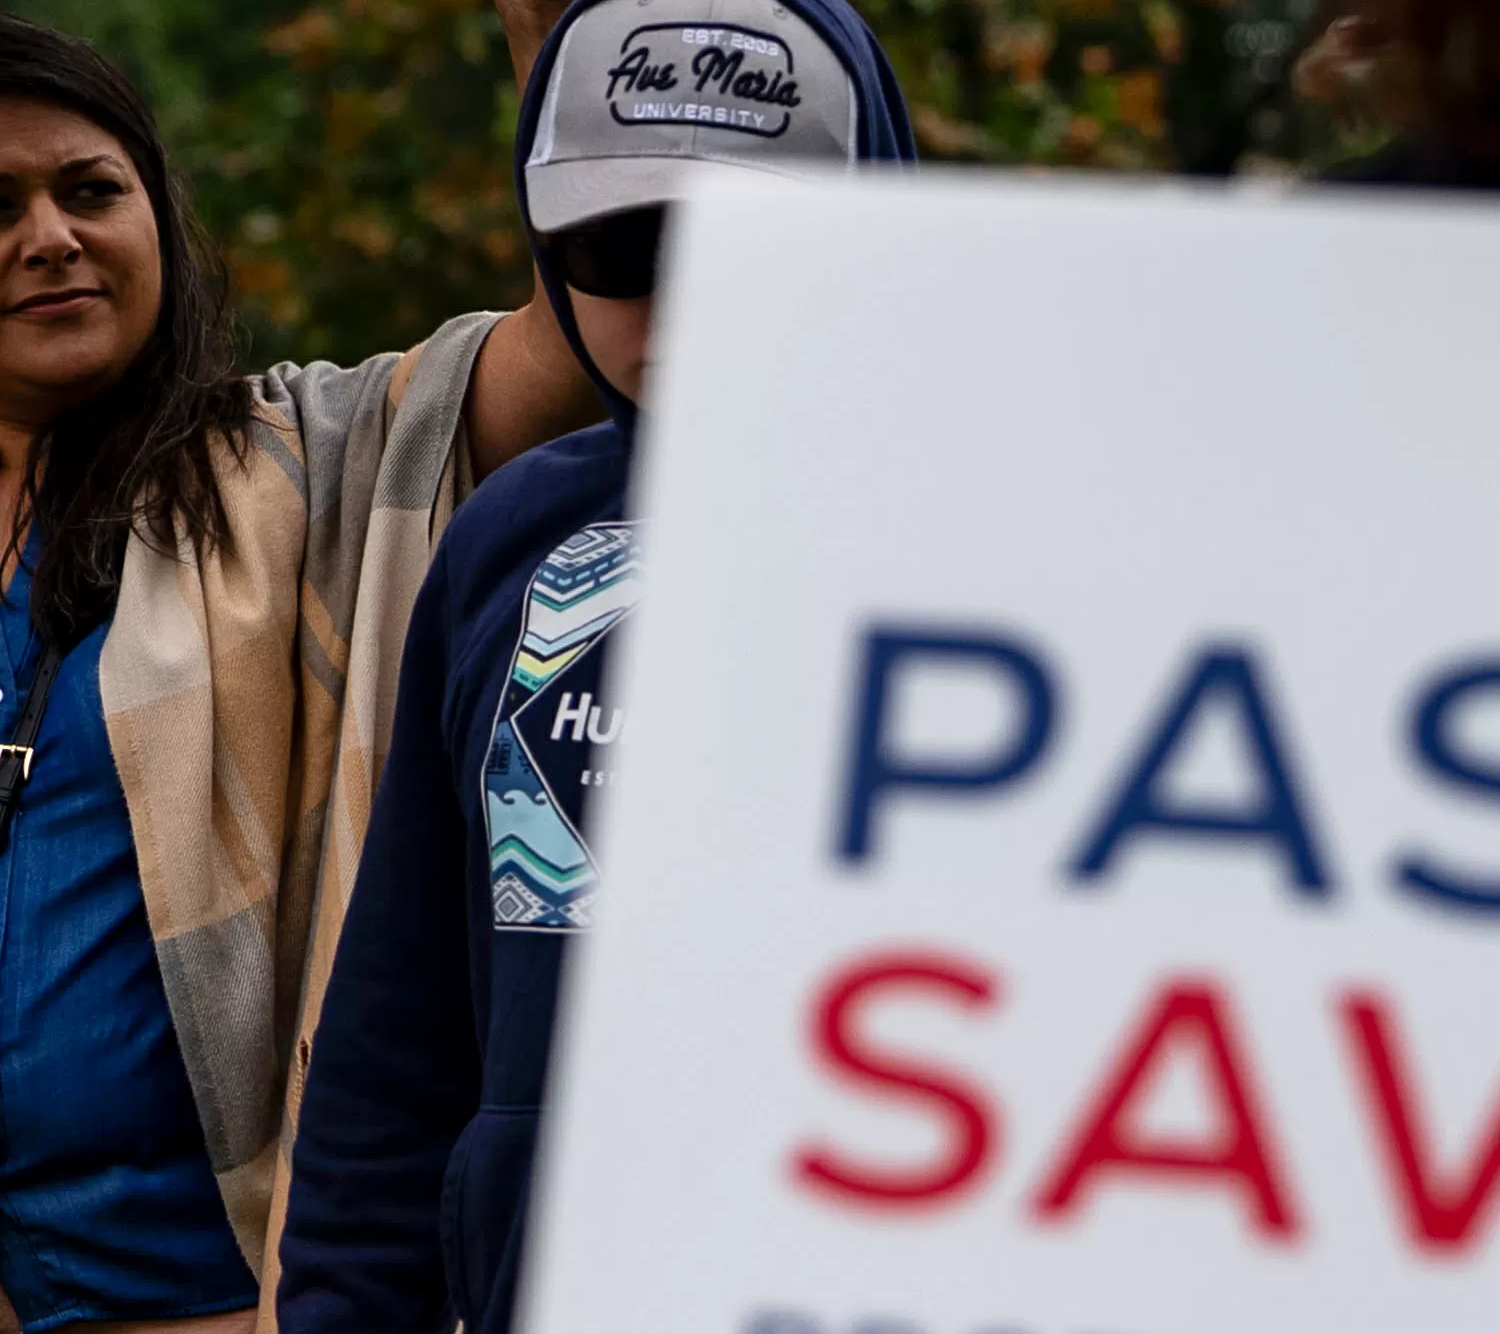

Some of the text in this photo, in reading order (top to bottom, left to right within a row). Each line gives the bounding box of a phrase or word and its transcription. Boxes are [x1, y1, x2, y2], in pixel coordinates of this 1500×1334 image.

[606, 46, 801, 107] Ave Maria
[633, 103, 765, 128] UNIVERSITY
